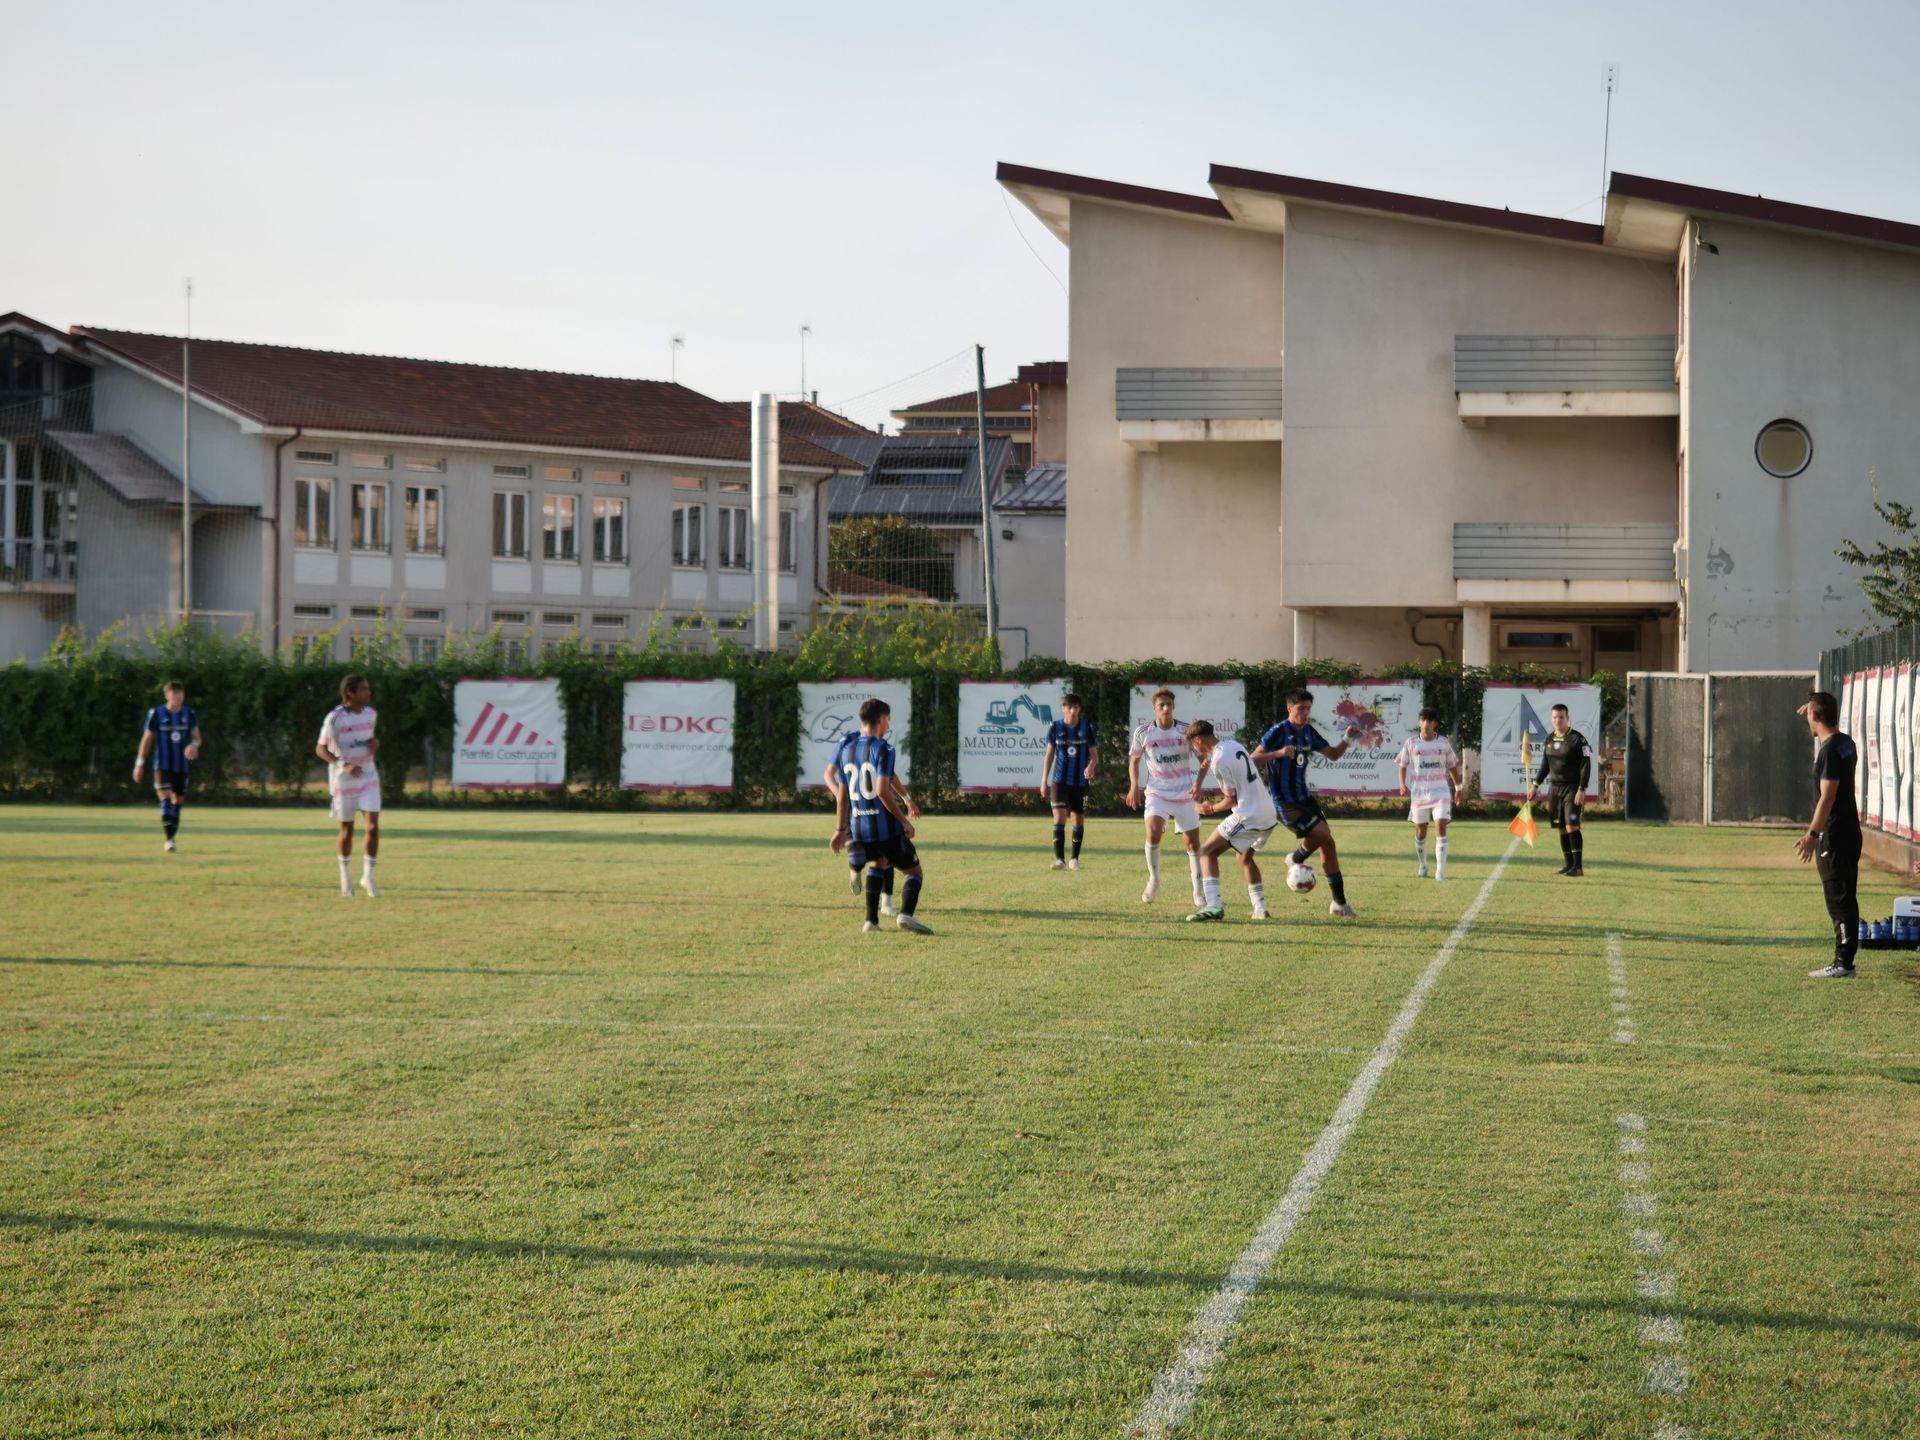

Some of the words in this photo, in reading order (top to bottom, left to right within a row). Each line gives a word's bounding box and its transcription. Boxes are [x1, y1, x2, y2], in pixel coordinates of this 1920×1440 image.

[825, 693, 872, 703] PASTICCER
[660, 715, 728, 733] DKC
[964, 737, 1016, 749] MAURO
[1019, 737, 1047, 749] GAS
[460, 749, 493, 760] Pianfei
[497, 749, 557, 760] Costruzioni
[1156, 753, 1181, 764] Jeep
[1343, 747, 1367, 760] abio
[1369, 747, 1398, 760] Cana
[1235, 750, 1257, 783] 2
[1310, 758, 1376, 770] Decorazioni
[843, 761, 877, 801] 20
